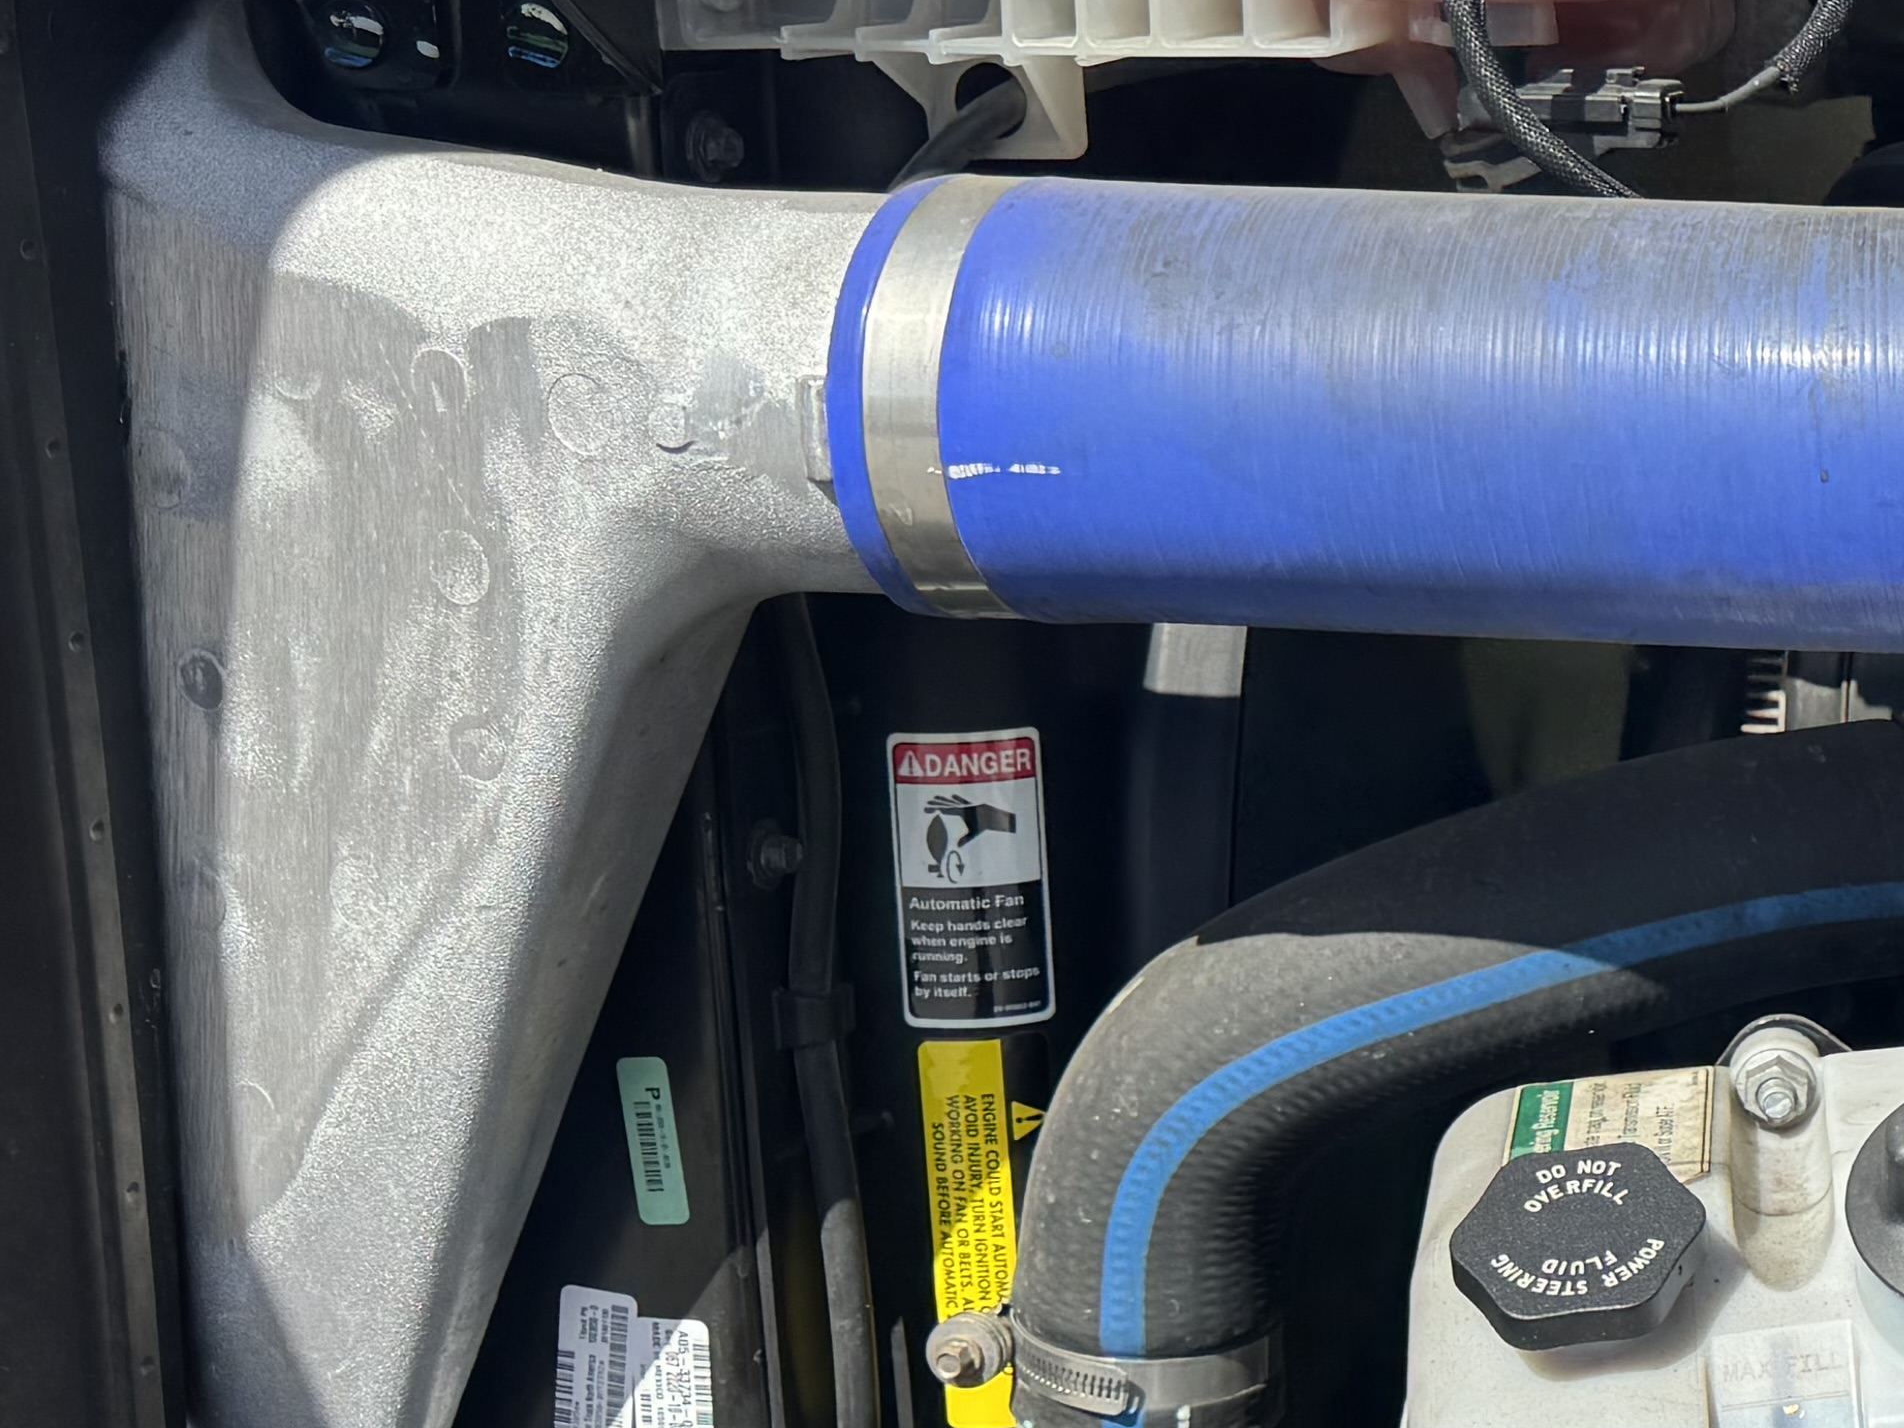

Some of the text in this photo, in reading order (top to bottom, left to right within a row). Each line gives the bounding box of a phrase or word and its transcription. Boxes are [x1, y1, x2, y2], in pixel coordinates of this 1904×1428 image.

[924, 748, 1032, 778] DANGER
[909, 894, 1024, 911] Automatic Fan
[910, 916, 1028, 933] Keep hands clear
[910, 933, 1013, 949] when engine is
[911, 951, 968, 965] running.
[913, 966, 1041, 983] Fan starts or stops
[914, 985, 931, 999] by
[645, 1087, 661, 1100] P
[981, 1093, 998, 1146] ENGINE
[986, 1149, 1001, 1196] COULD
[1535, 1159, 1622, 1184] DO NOT
[945, 1094, 972, 1293] WORKING ON FAN OR BELTS.
[963, 1094, 991, 1302] AVOID INJURY, TURN IGNITION
[1523, 1179, 1630, 1213] OVERFILL
[932, 1122, 959, 1308] SOUND BEFORE AUTOMATIC
[990, 1200, 1005, 1239] START
[1490, 1238, 1665, 1296] POWER STEERING
[1542, 1250, 1618, 1276] FLUID
